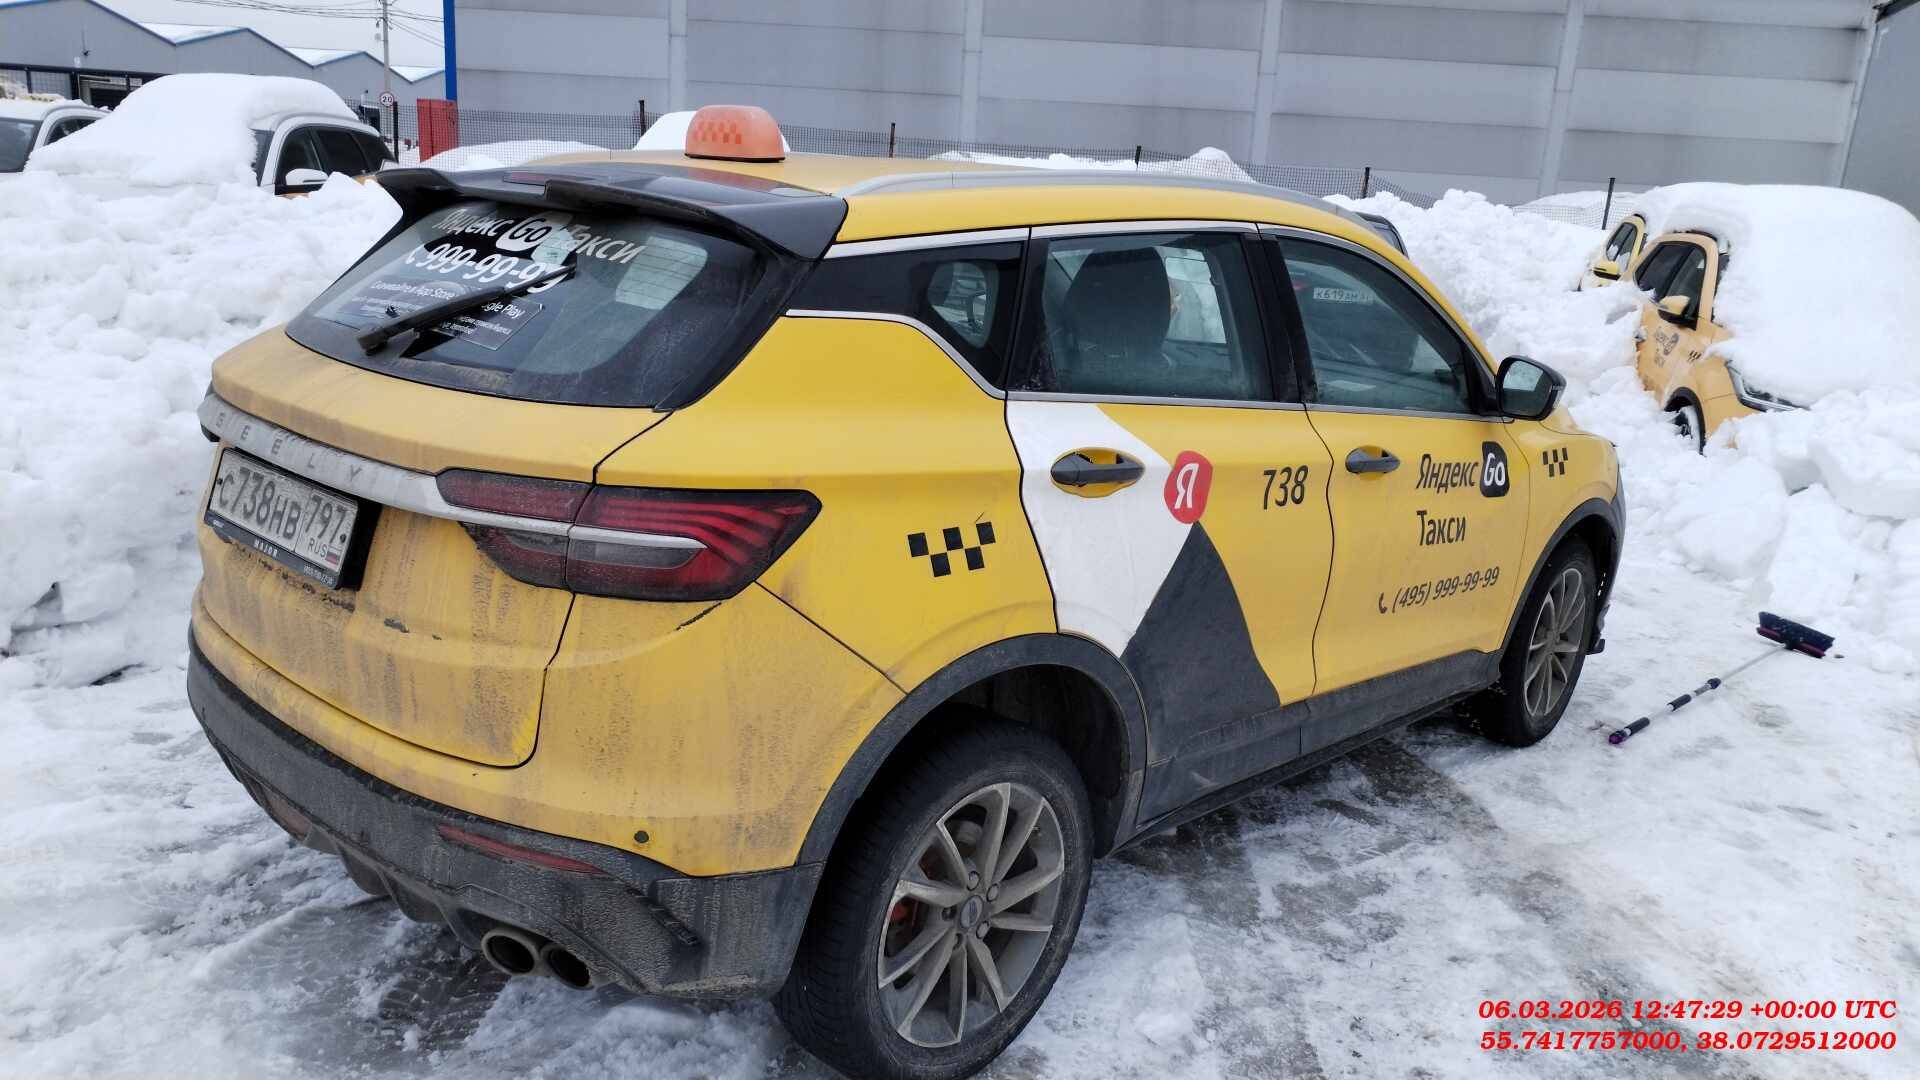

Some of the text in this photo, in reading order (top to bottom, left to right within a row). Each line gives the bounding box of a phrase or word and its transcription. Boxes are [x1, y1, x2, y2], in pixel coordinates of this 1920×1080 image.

[432, 208, 648, 265] Яндекс Go Такси
[1174, 463, 1199, 509] Я
[1263, 465, 1309, 510] 738
[1416, 453, 1506, 494] Яндекс Go
[219, 467, 300, 540] С738НВ
[304, 493, 346, 543] 797
[307, 537, 328, 559] RUS
[1416, 510, 1466, 546] Такси
[1392, 566, 1500, 613] (495) 999-99-99
